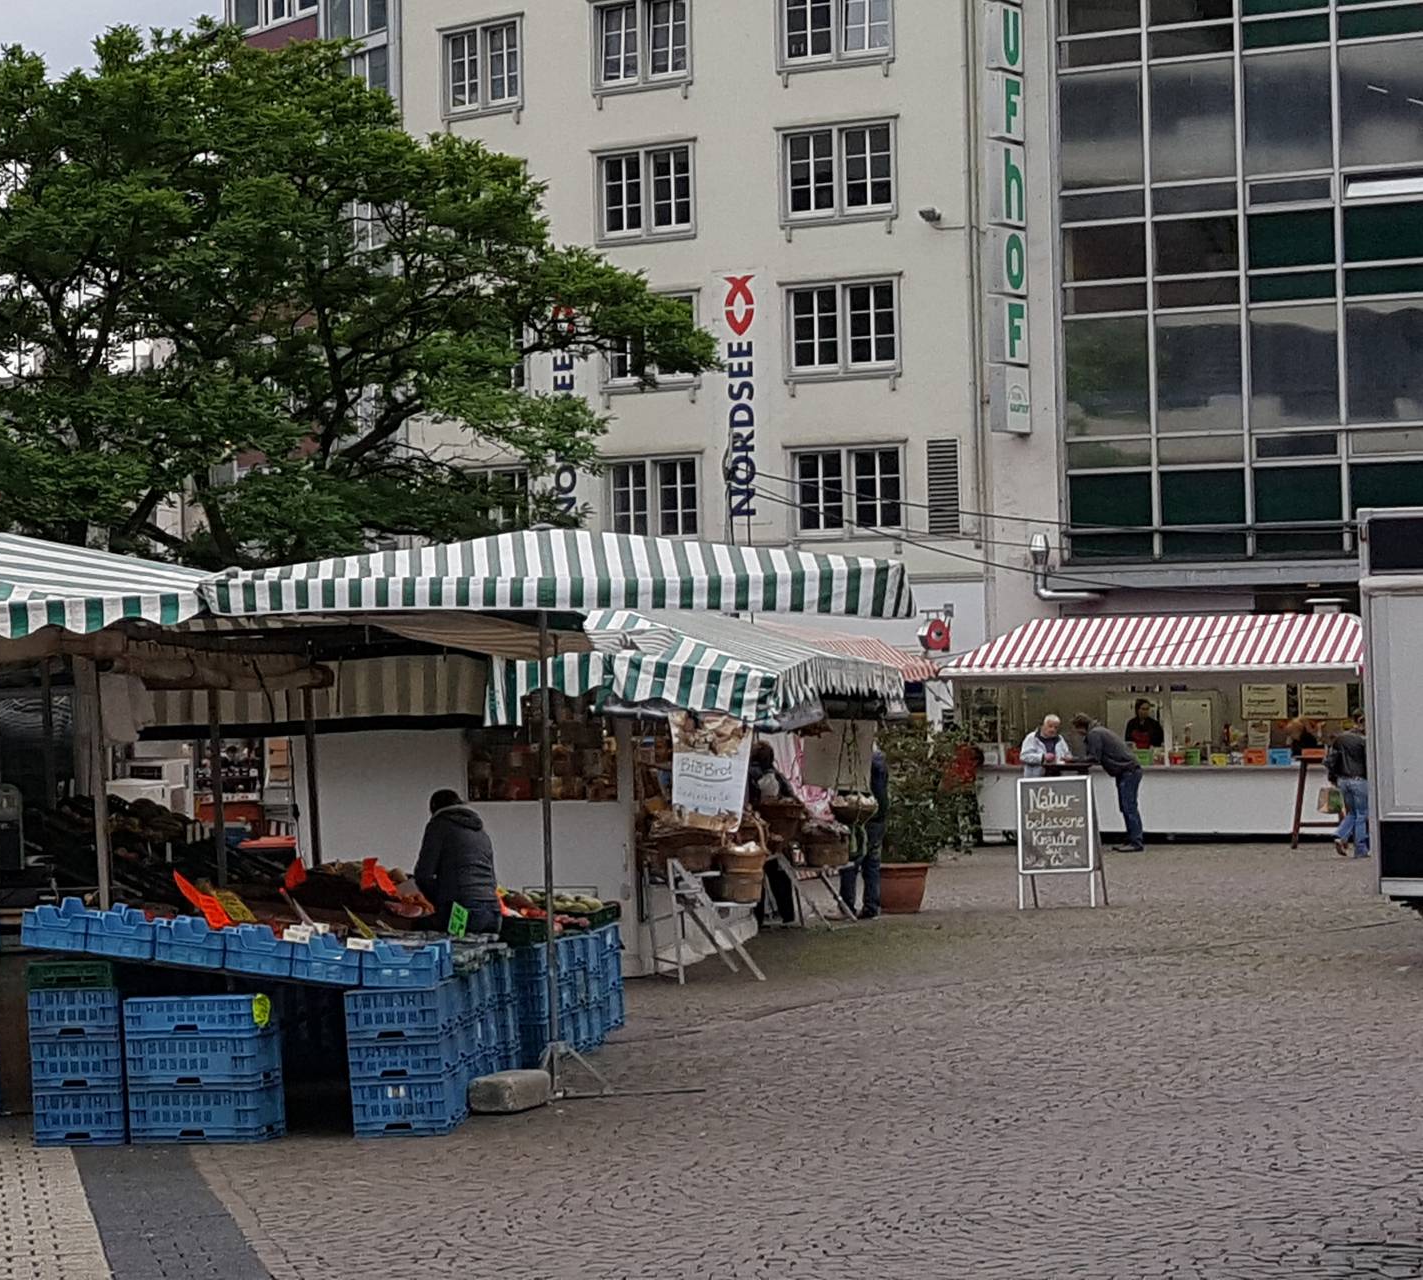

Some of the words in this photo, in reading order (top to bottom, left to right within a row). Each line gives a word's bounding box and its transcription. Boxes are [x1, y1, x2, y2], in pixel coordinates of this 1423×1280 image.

[727, 341, 756, 516] NORDSEE
[1028, 785, 1080, 813] Natur-
[1025, 813, 1085, 831] belassene
[1032, 830, 1081, 847] Kräuter
